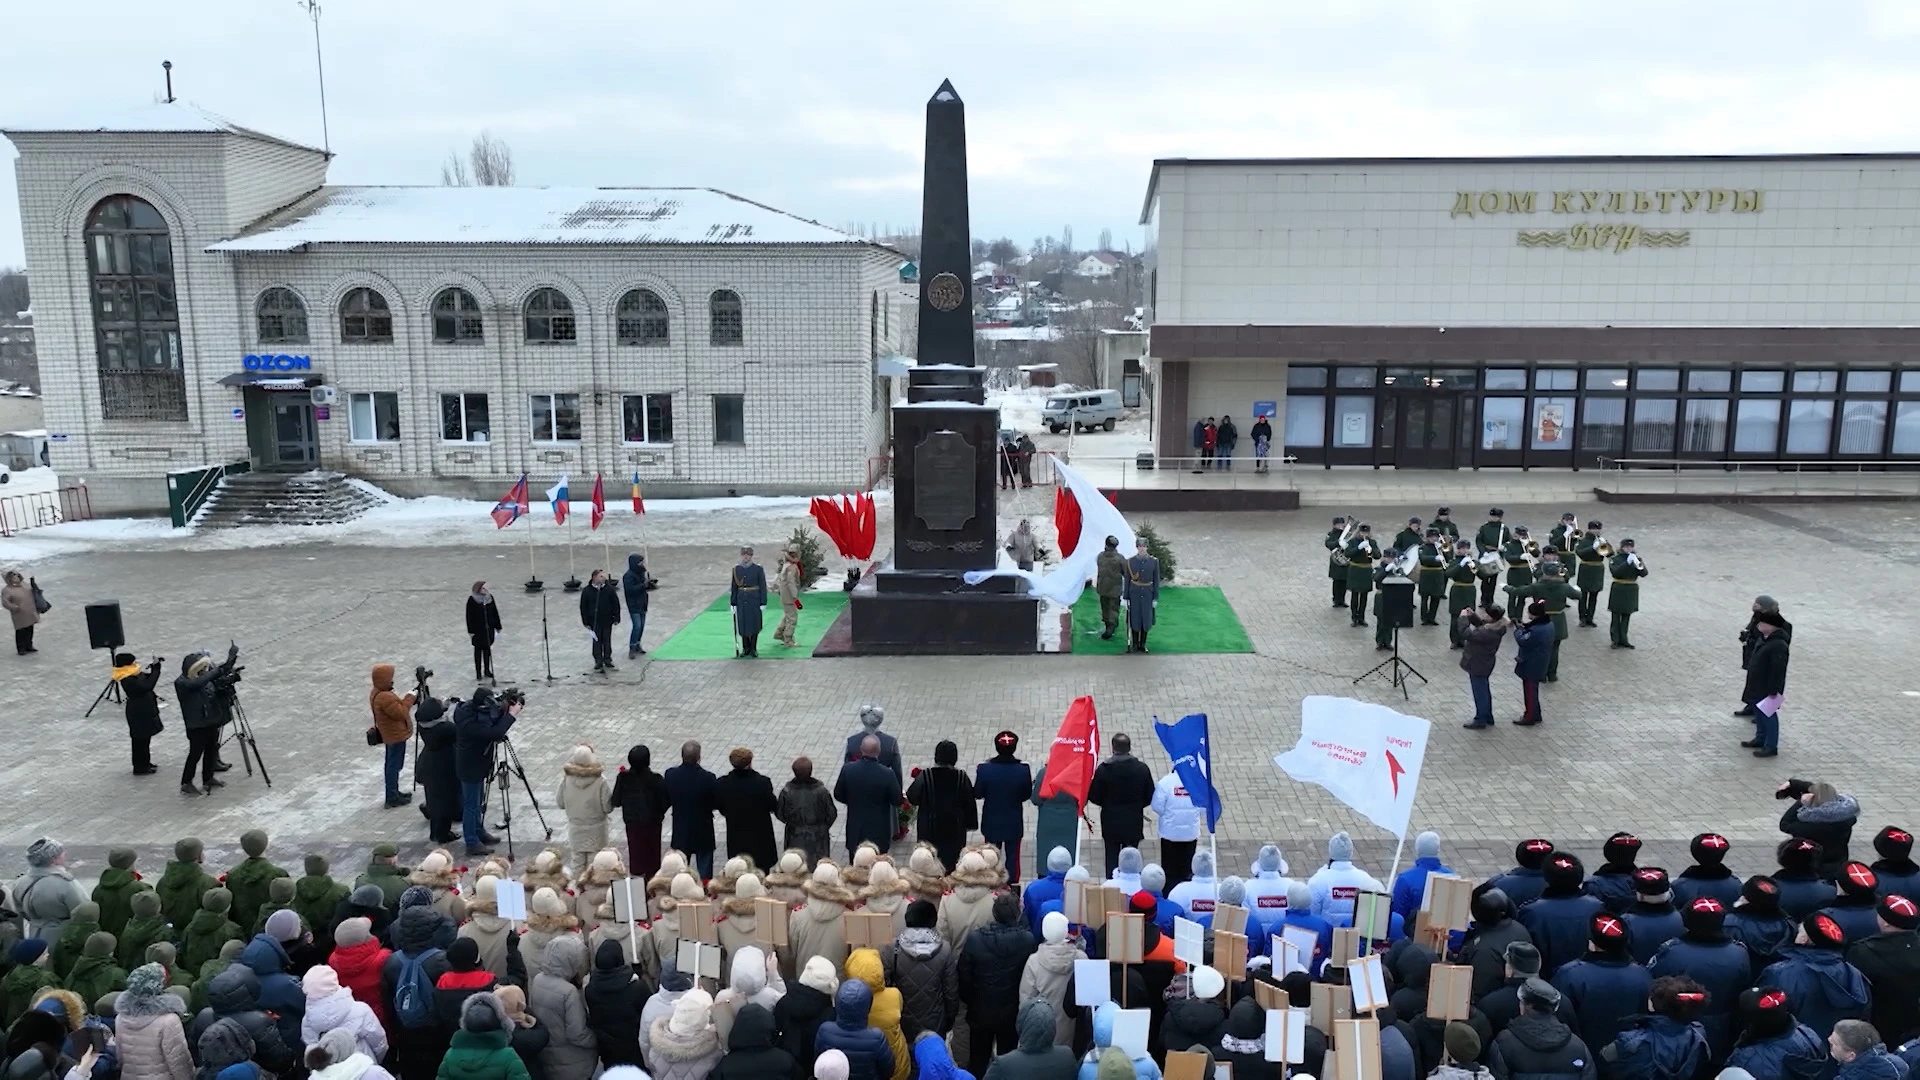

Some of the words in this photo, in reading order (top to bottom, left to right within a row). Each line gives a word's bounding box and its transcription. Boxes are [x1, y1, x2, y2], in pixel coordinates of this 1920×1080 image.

[1451, 191, 1537, 218] ДОМ
[1552, 189, 1765, 214] КУЛЬТУРЫ
[243, 354, 311, 372] OZON
